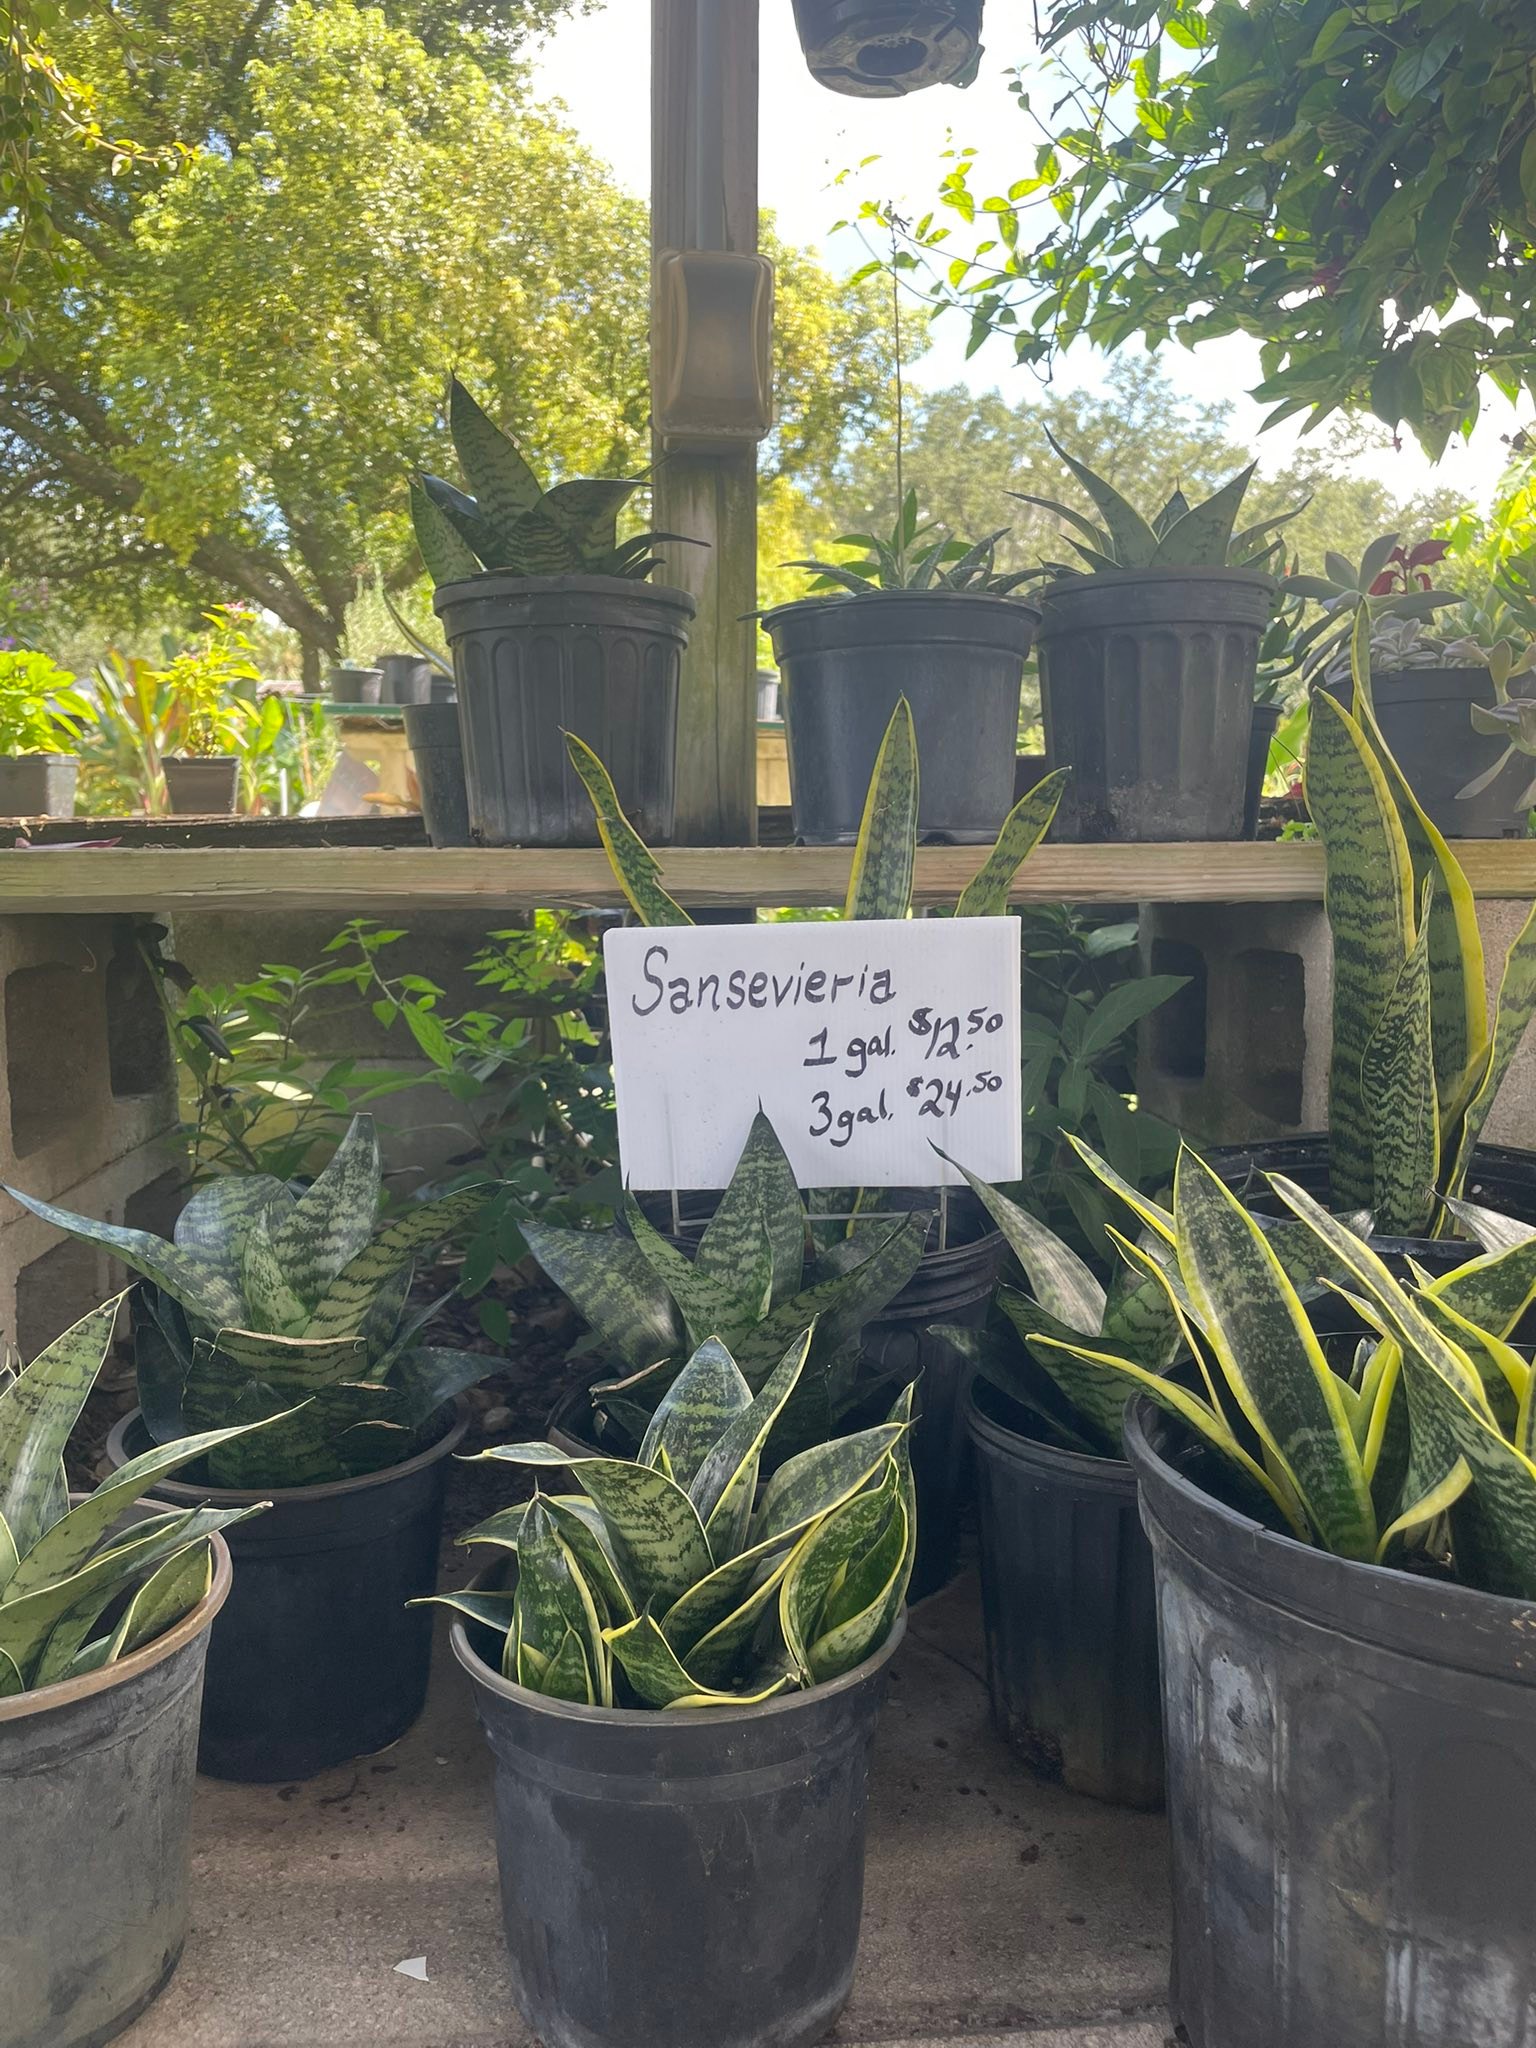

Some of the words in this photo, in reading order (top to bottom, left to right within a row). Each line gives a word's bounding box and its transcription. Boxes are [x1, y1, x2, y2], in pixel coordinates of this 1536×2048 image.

[630, 944, 897, 1017] Sansevieria
[803, 1026, 838, 1067] 1
[844, 1024, 896, 1078] gal.
[905, 1070, 1003, 1118] $24.50
